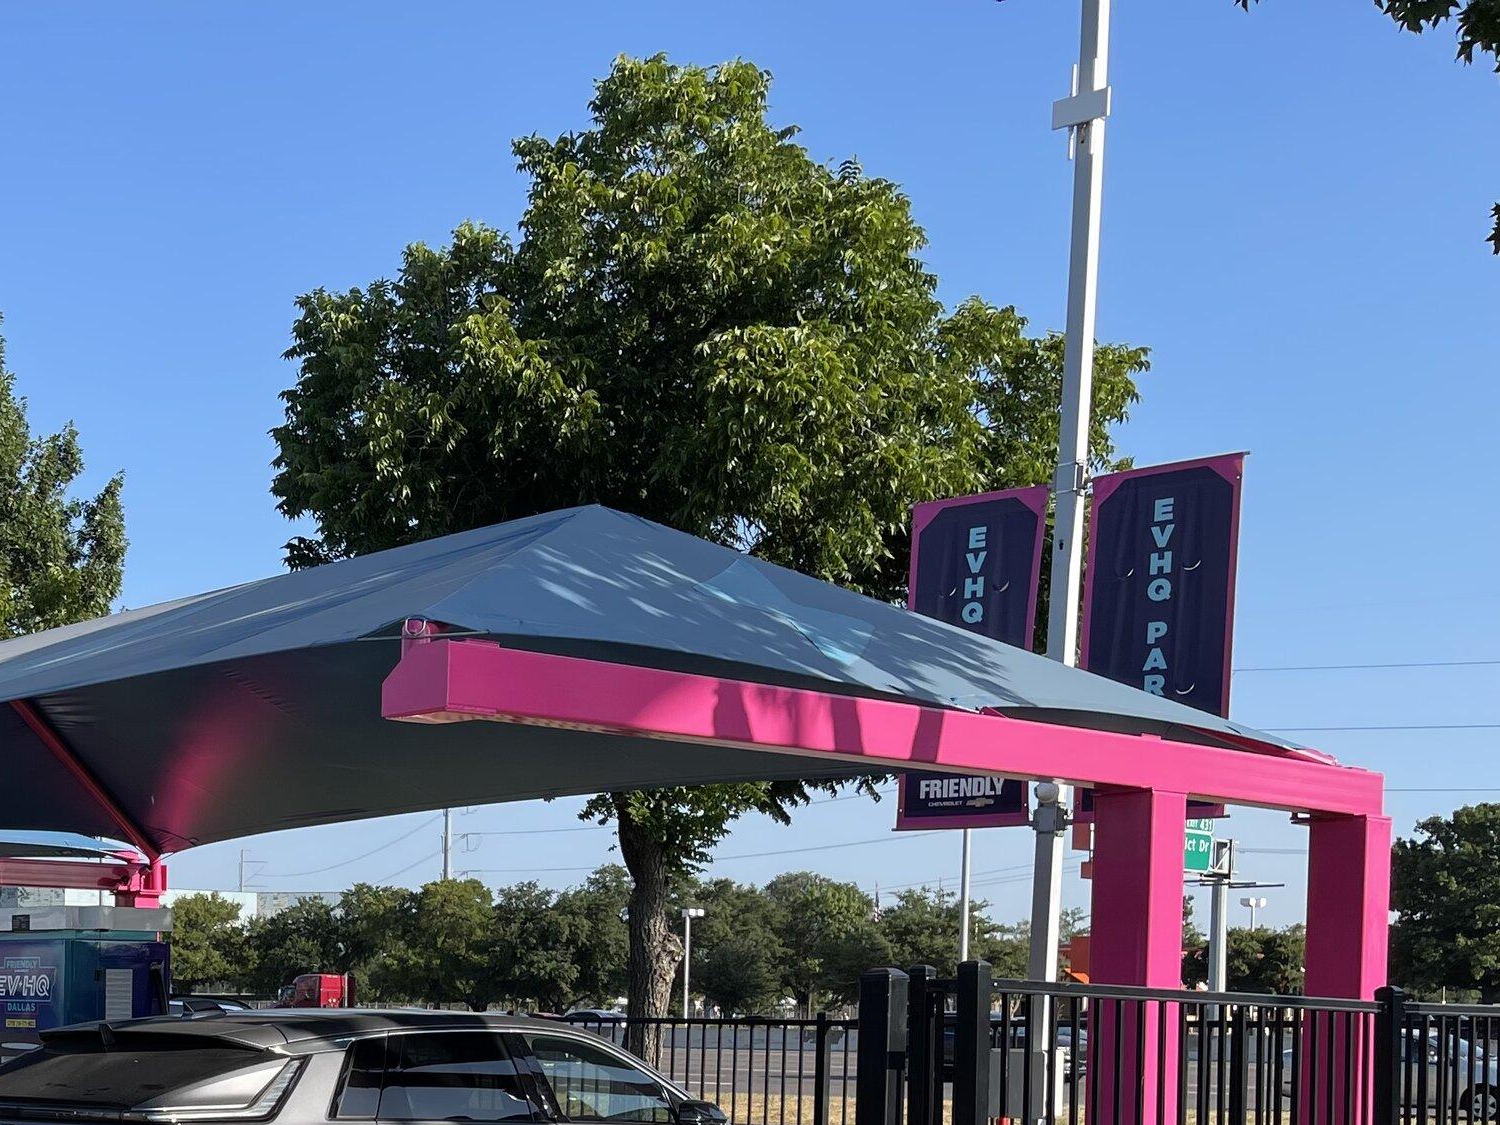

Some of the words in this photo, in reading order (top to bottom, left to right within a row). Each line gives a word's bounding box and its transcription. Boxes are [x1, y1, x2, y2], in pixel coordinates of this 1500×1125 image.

[1147, 497, 1176, 602] EVHQ
[961, 526, 988, 624] EVHQ
[919, 776, 1005, 800] FRIENDLY
[1198, 839, 1210, 853] Dr
[6, 960, 37, 969] FRIENDLY
[7, 1003, 36, 1012] DALLAS
